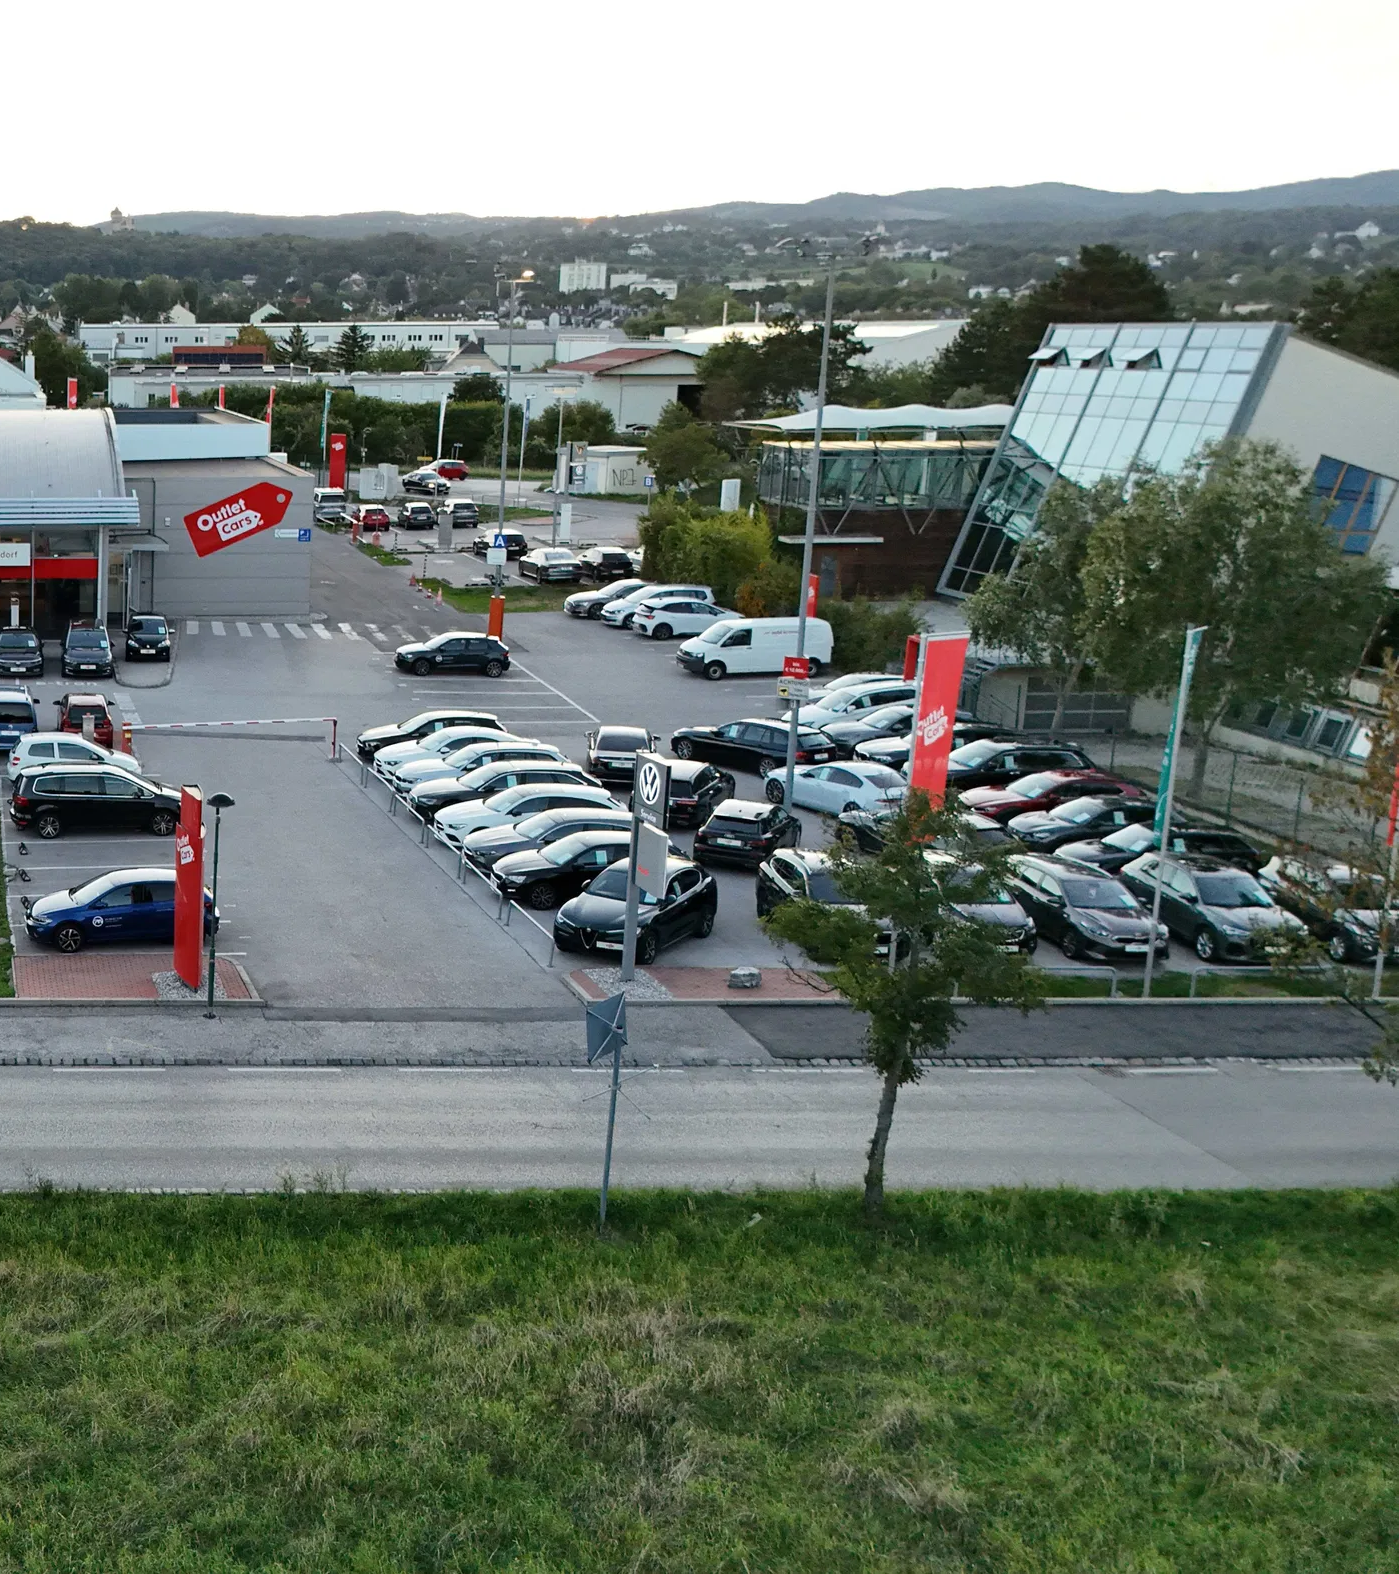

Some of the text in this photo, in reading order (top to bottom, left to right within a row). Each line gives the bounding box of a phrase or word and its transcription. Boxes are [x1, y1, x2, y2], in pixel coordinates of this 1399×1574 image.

[645, 477, 652, 486] B
[197, 498, 246, 531] Outlet
[221, 516, 252, 534] Cars
[495, 535, 505, 547] A
